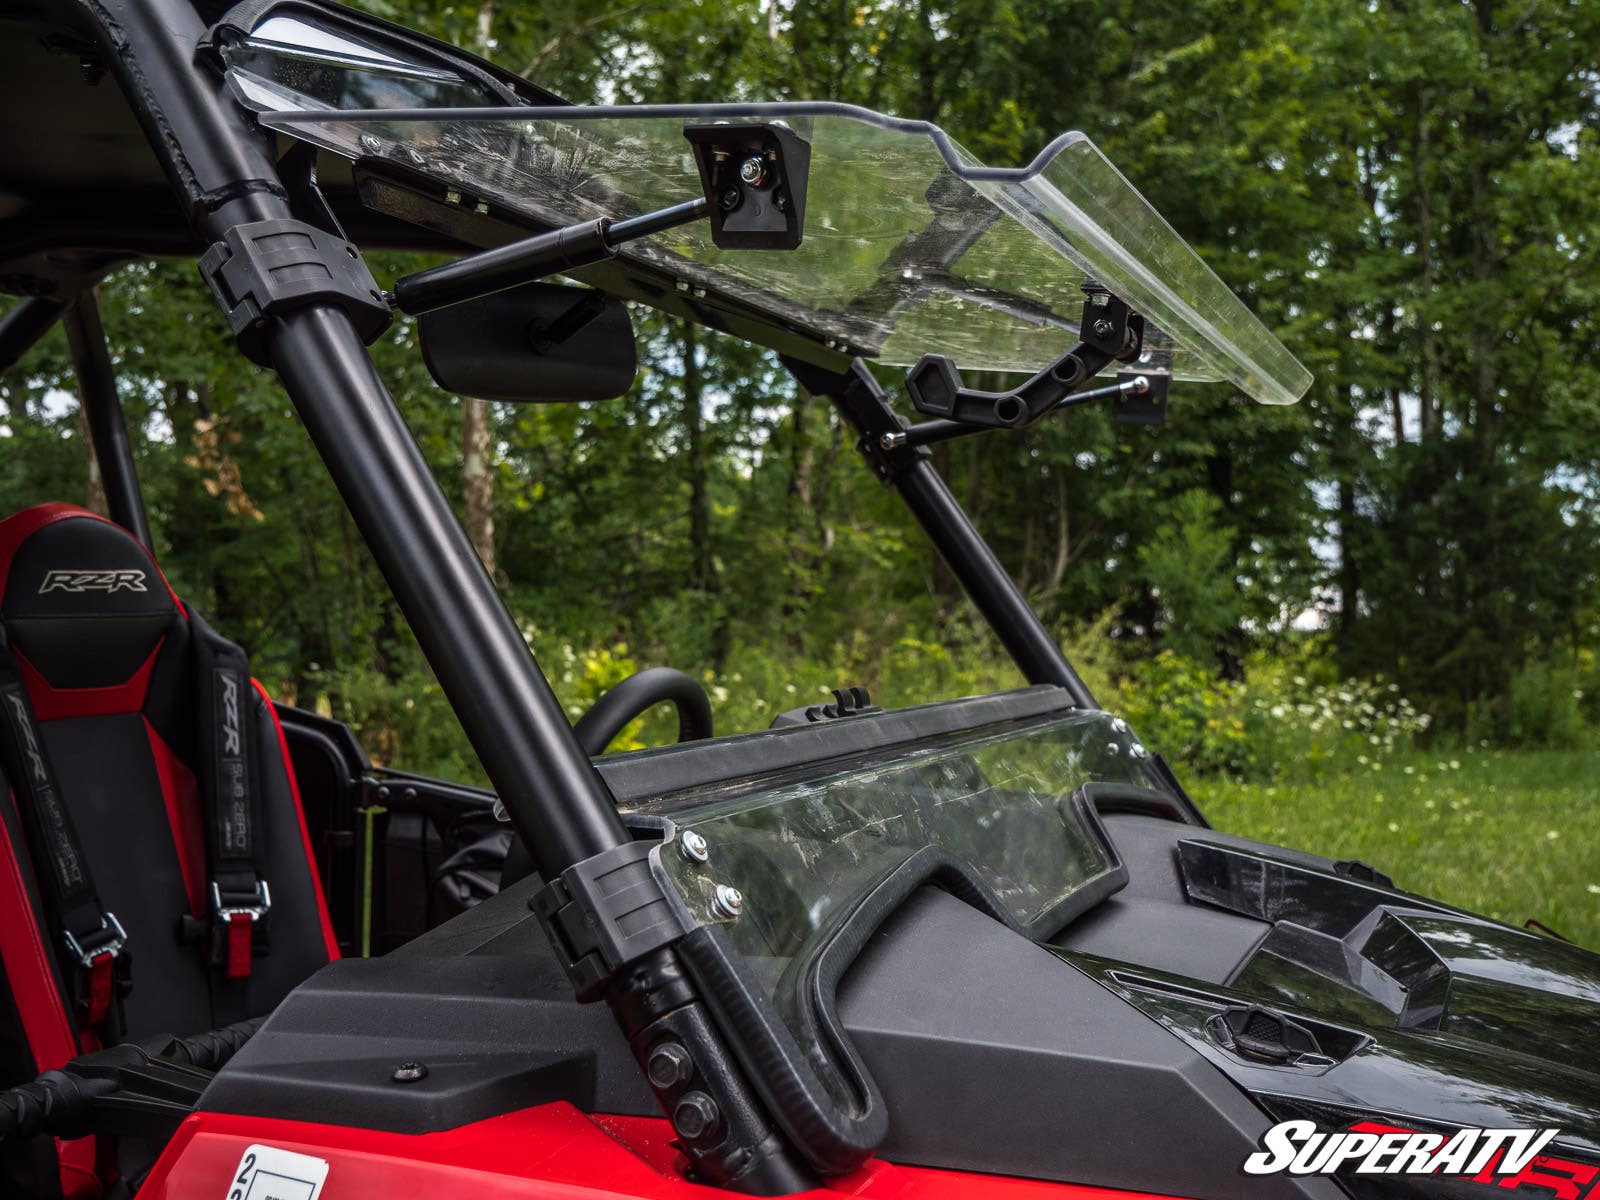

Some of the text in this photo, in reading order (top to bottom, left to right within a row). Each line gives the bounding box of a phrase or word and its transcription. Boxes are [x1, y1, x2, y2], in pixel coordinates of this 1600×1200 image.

[38, 570, 148, 594] RZR
[6, 693, 48, 781] RZR
[219, 674, 248, 849] RZR SUB ZERO
